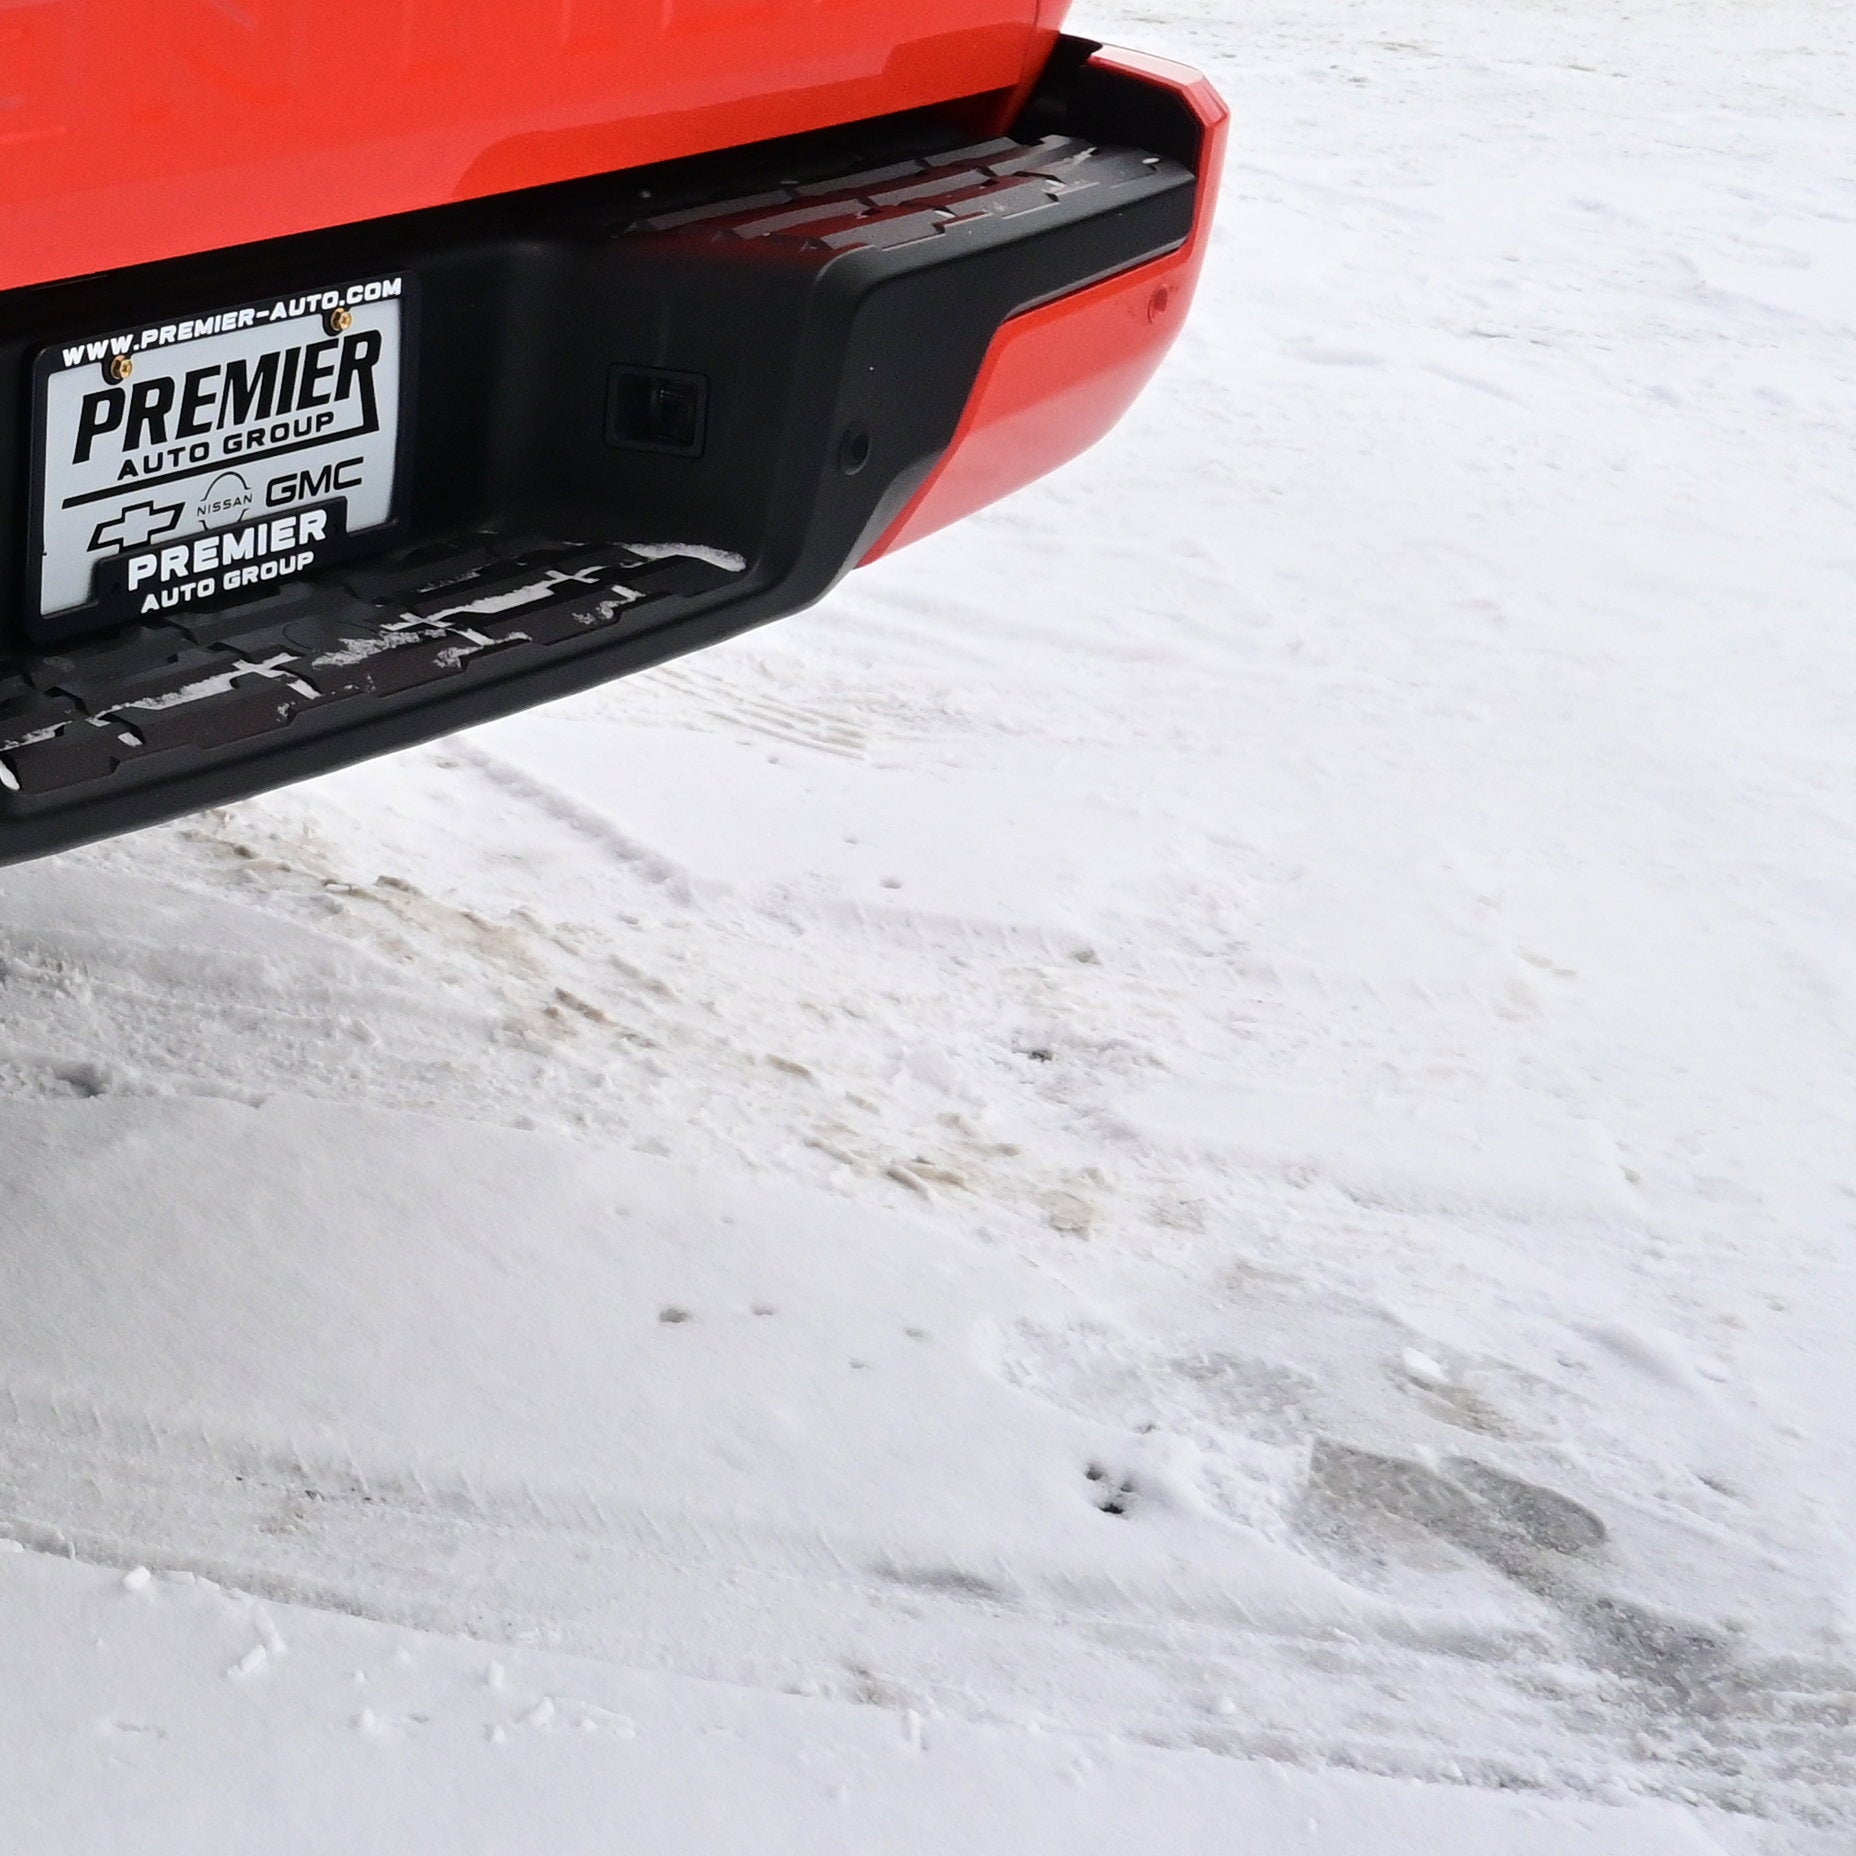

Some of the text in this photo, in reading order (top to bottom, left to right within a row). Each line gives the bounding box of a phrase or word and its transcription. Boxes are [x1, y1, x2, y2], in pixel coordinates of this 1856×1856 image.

[62, 277, 402, 366] WWW.PREMIER-AUTO.COM
[72, 330, 381, 465] PREMIER
[117, 411, 335, 481] AUTO GROUP
[197, 493, 253, 517] NISSAN
[265, 456, 364, 508] GMC
[127, 509, 327, 591] PREMIER
[141, 551, 315, 614] AUTO GROUP
